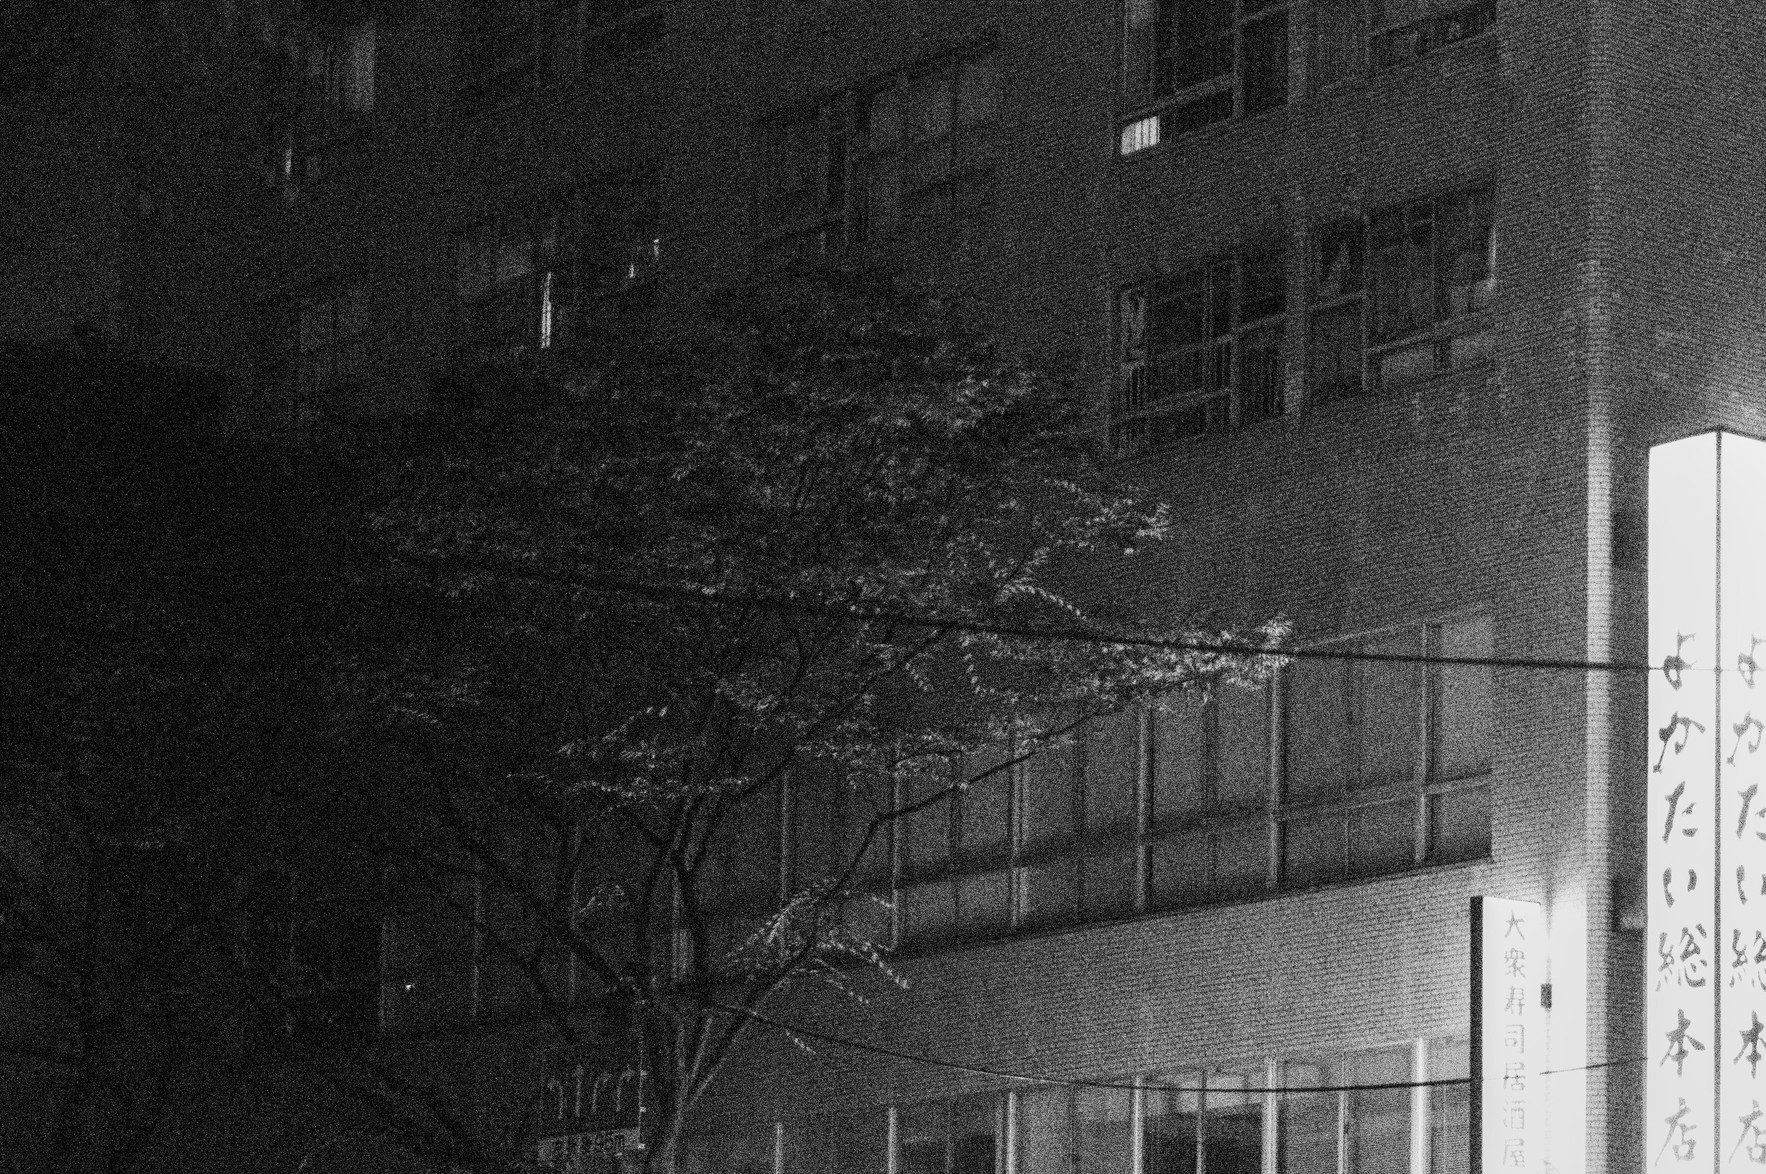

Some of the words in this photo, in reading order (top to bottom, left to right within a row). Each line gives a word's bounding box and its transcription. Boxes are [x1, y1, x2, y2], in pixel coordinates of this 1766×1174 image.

[1502, 911, 1527, 1169] 大衆寿司居酒屋
[1652, 629, 1709, 1167] よかたい総本店
